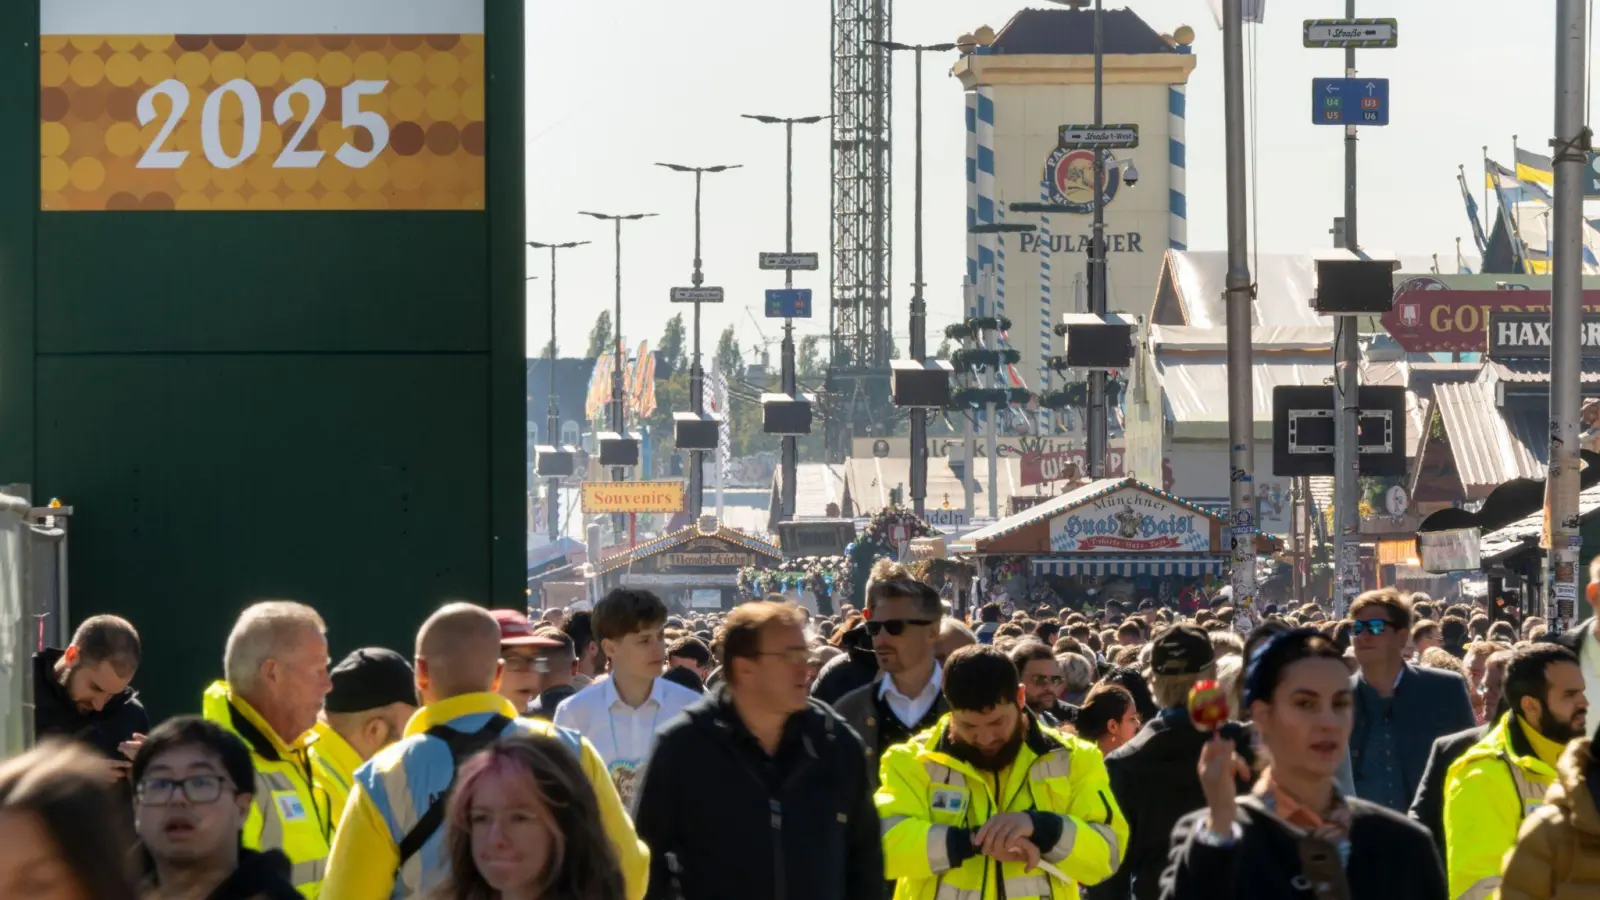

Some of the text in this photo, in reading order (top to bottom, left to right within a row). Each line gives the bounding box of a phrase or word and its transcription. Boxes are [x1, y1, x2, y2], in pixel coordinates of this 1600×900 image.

[1332, 28, 1362, 38] Straße
[1326, 98, 1339, 106] U4
[1364, 99, 1377, 107] U3
[1326, 111, 1339, 119] U5
[1364, 112, 1377, 120] U6
[136, 78, 390, 169] 2025
[1084, 132, 1110, 141] Straße
[594, 490, 672, 505] Souvenirs
[1093, 493, 1169, 512] Münchner
